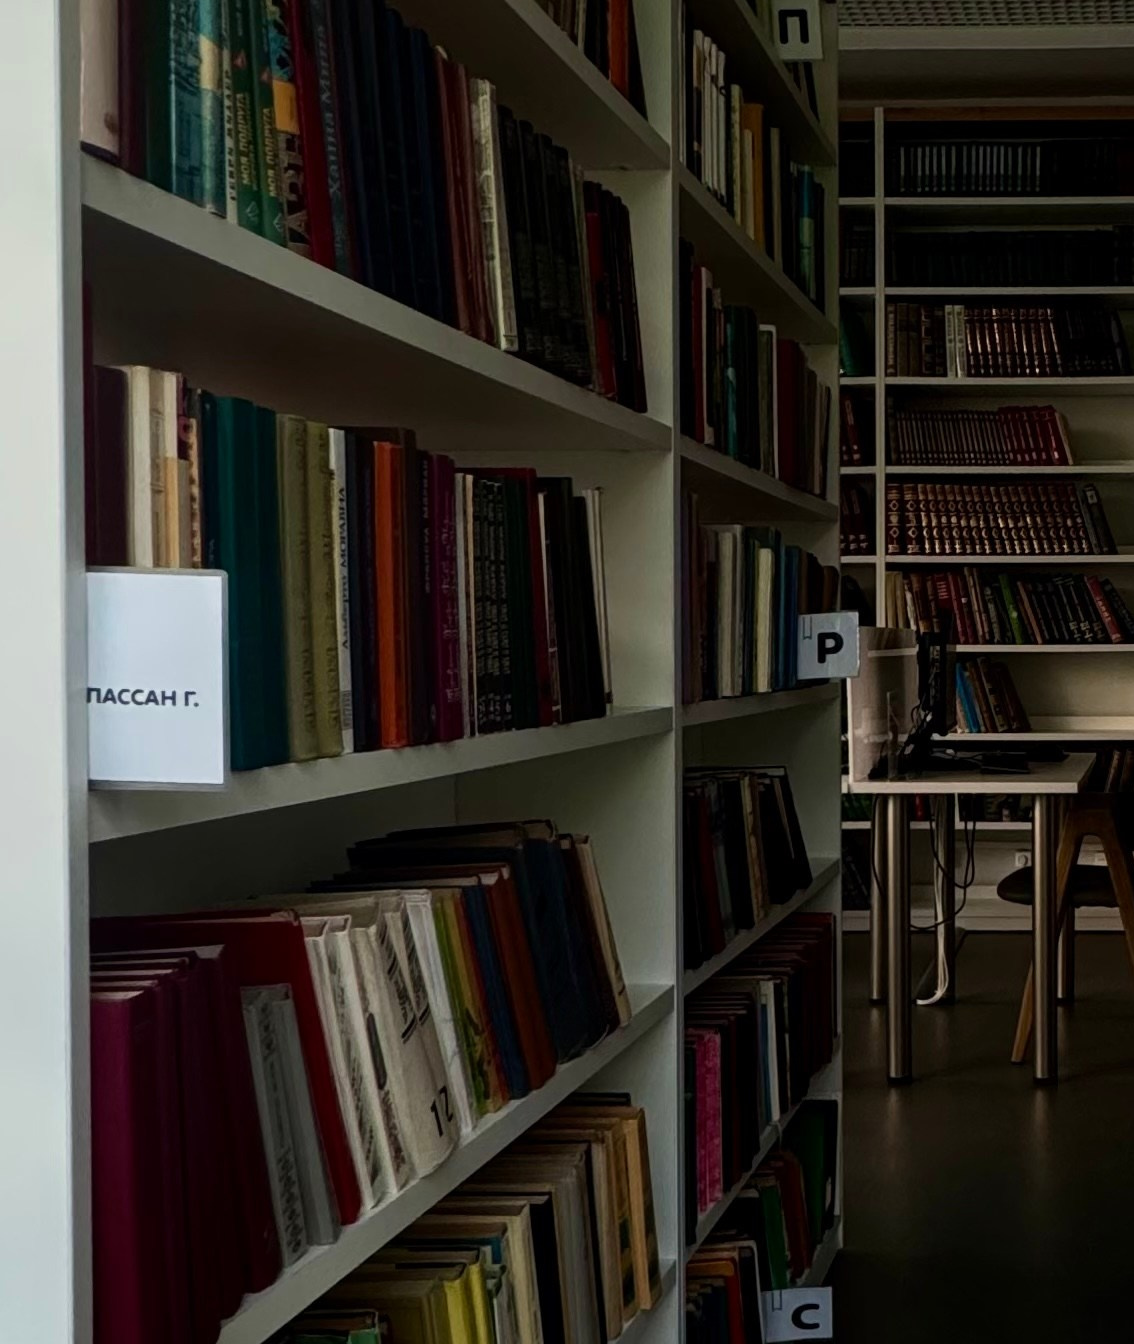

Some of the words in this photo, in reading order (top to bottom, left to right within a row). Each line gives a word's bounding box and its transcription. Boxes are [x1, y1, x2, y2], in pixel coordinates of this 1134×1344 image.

[779, 9, 809, 44] П
[236, 91, 249, 155] ПОДРУГА
[262, 106, 276, 169] ПОДРУГА
[239, 157, 251, 188] МОЯ
[267, 171, 279, 197] МОЯ
[336, 486, 347, 568] МОРАВИА
[339, 574, 350, 649] Альберто
[817, 631, 844, 663] Р
[86, 687, 177, 706] ПАССАН
[184, 691, 199, 707] Г.
[792, 1304, 820, 1330] С
